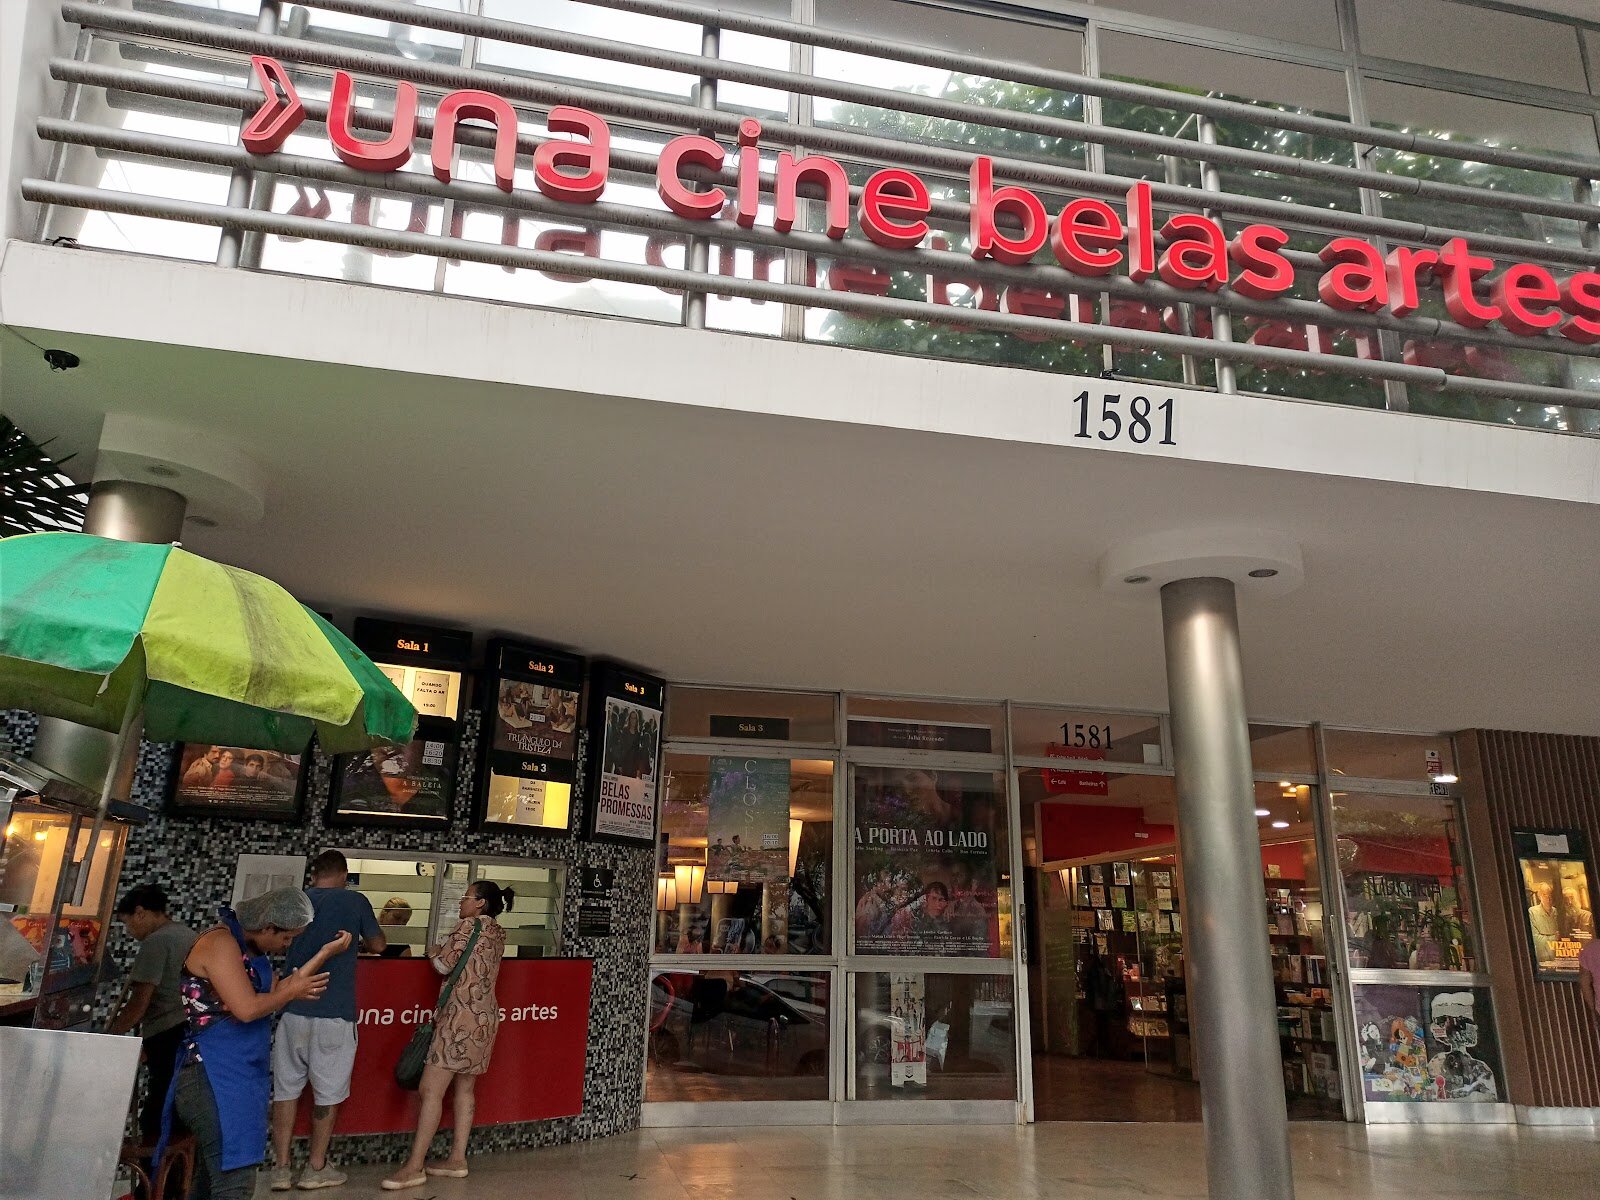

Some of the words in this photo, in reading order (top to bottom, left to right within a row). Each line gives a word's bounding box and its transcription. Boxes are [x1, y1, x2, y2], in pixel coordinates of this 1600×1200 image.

[326, 70, 610, 203] una
[656, 118, 932, 248] cine
[970, 156, 1294, 300] belas
[1318, 237, 1600, 345] artes
[1073, 390, 1177, 446] 1581
[397, 639, 420, 651] Sala
[423, 643, 429, 652] 1
[528, 660, 546, 672] Sala
[548, 664, 554, 673] 2
[624, 682, 638, 693] Sala
[640, 686, 645, 695] 3
[738, 723, 756, 732] Sala
[757, 724, 764, 732] 3
[1060, 722, 1114, 750] 1581
[517, 741, 552, 755] TRISTEZA
[521, 761, 539, 772] Sala
[540, 763, 547, 773] 3
[601, 780, 630, 800] BELAS
[600, 797, 652, 821] PROMESSAS
[855, 827, 863, 844] A
[868, 827, 919, 846] PORTA
[924, 829, 944, 846] AO
[949, 830, 988, 848] LADO
[400, 1004, 436, 1025] cin
[510, 1003, 558, 1022] artes
